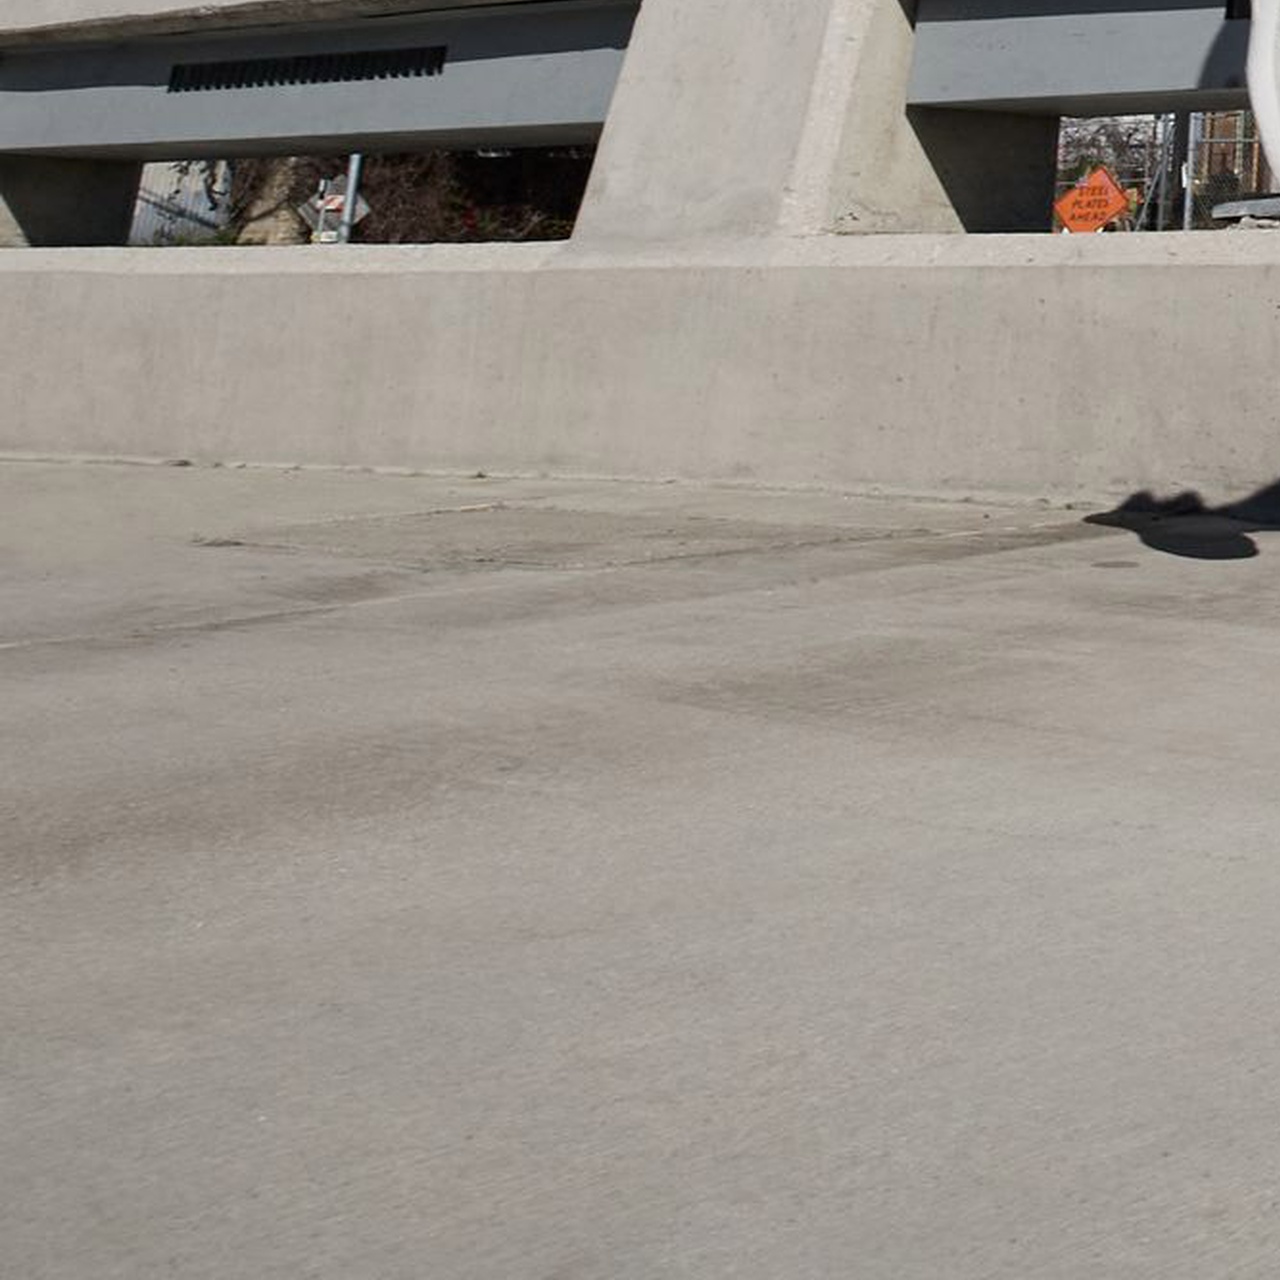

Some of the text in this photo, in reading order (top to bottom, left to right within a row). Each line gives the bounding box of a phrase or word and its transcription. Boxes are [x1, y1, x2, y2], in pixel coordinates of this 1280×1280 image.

[1079, 185, 1109, 197] STEEL
[1073, 198, 1109, 209] PLATES
[1070, 211, 1106, 222] AHEAD
